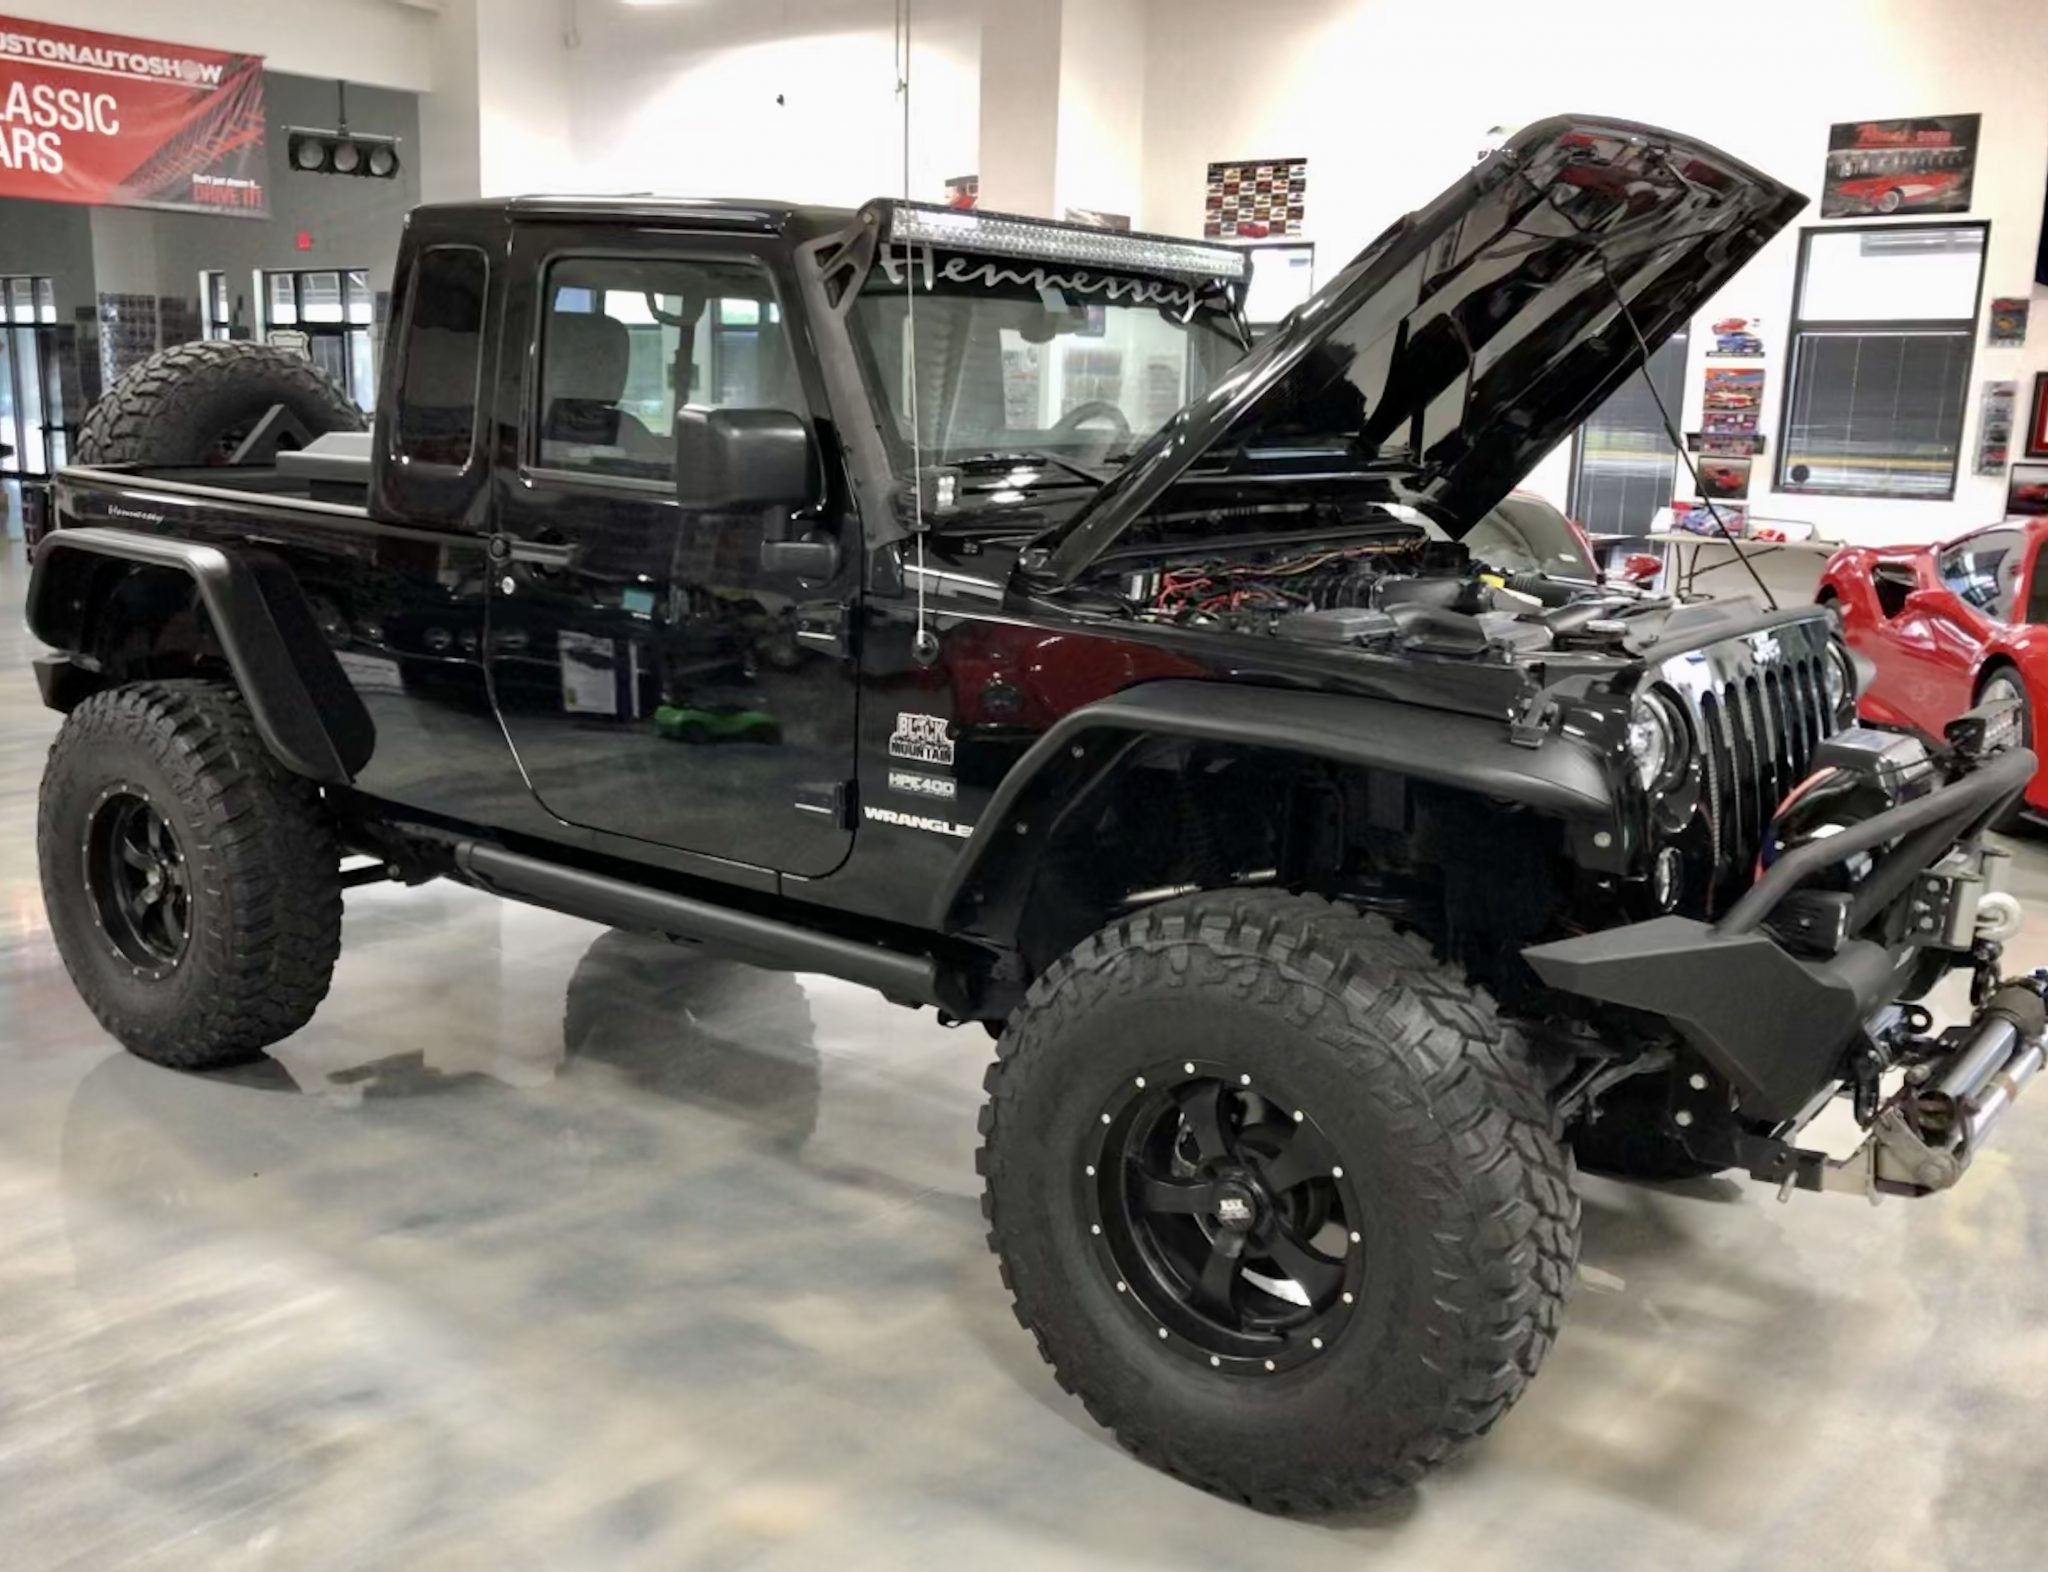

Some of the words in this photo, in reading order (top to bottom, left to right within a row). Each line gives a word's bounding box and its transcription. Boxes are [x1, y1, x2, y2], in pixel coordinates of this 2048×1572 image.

[0, 81, 120, 136] ASSIC
[879, 241, 1204, 324] Hennessey
[898, 715, 947, 743] BLACK
[891, 740, 952, 764] MOUNTAIN
[864, 806, 974, 838] WRANGLE
